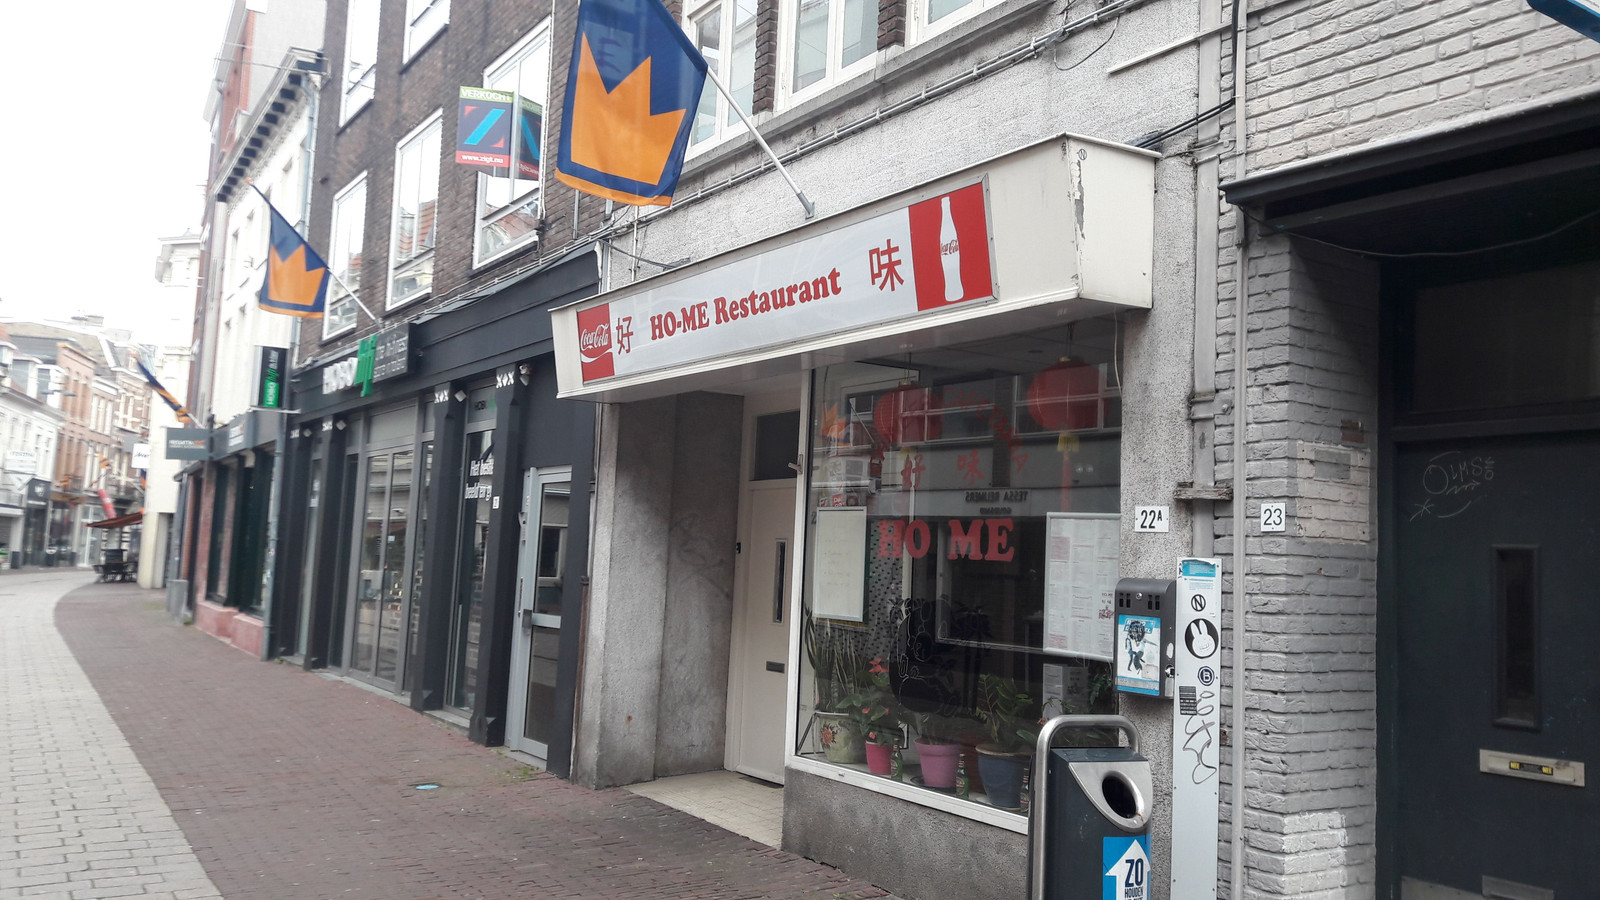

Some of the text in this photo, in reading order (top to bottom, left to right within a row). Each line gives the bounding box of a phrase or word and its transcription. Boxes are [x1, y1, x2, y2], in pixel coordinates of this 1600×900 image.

[461, 89, 511, 101] VERKOCHT
[869, 239, 904, 292] 味
[650, 267, 842, 341] HO-ME Restaurant
[616, 316, 634, 355] 好
[1140, 509, 1163, 529] 22A
[1263, 508, 1283, 526] 23
[877, 517, 1015, 562] HO ME
[1125, 857, 1144, 887] ZO
